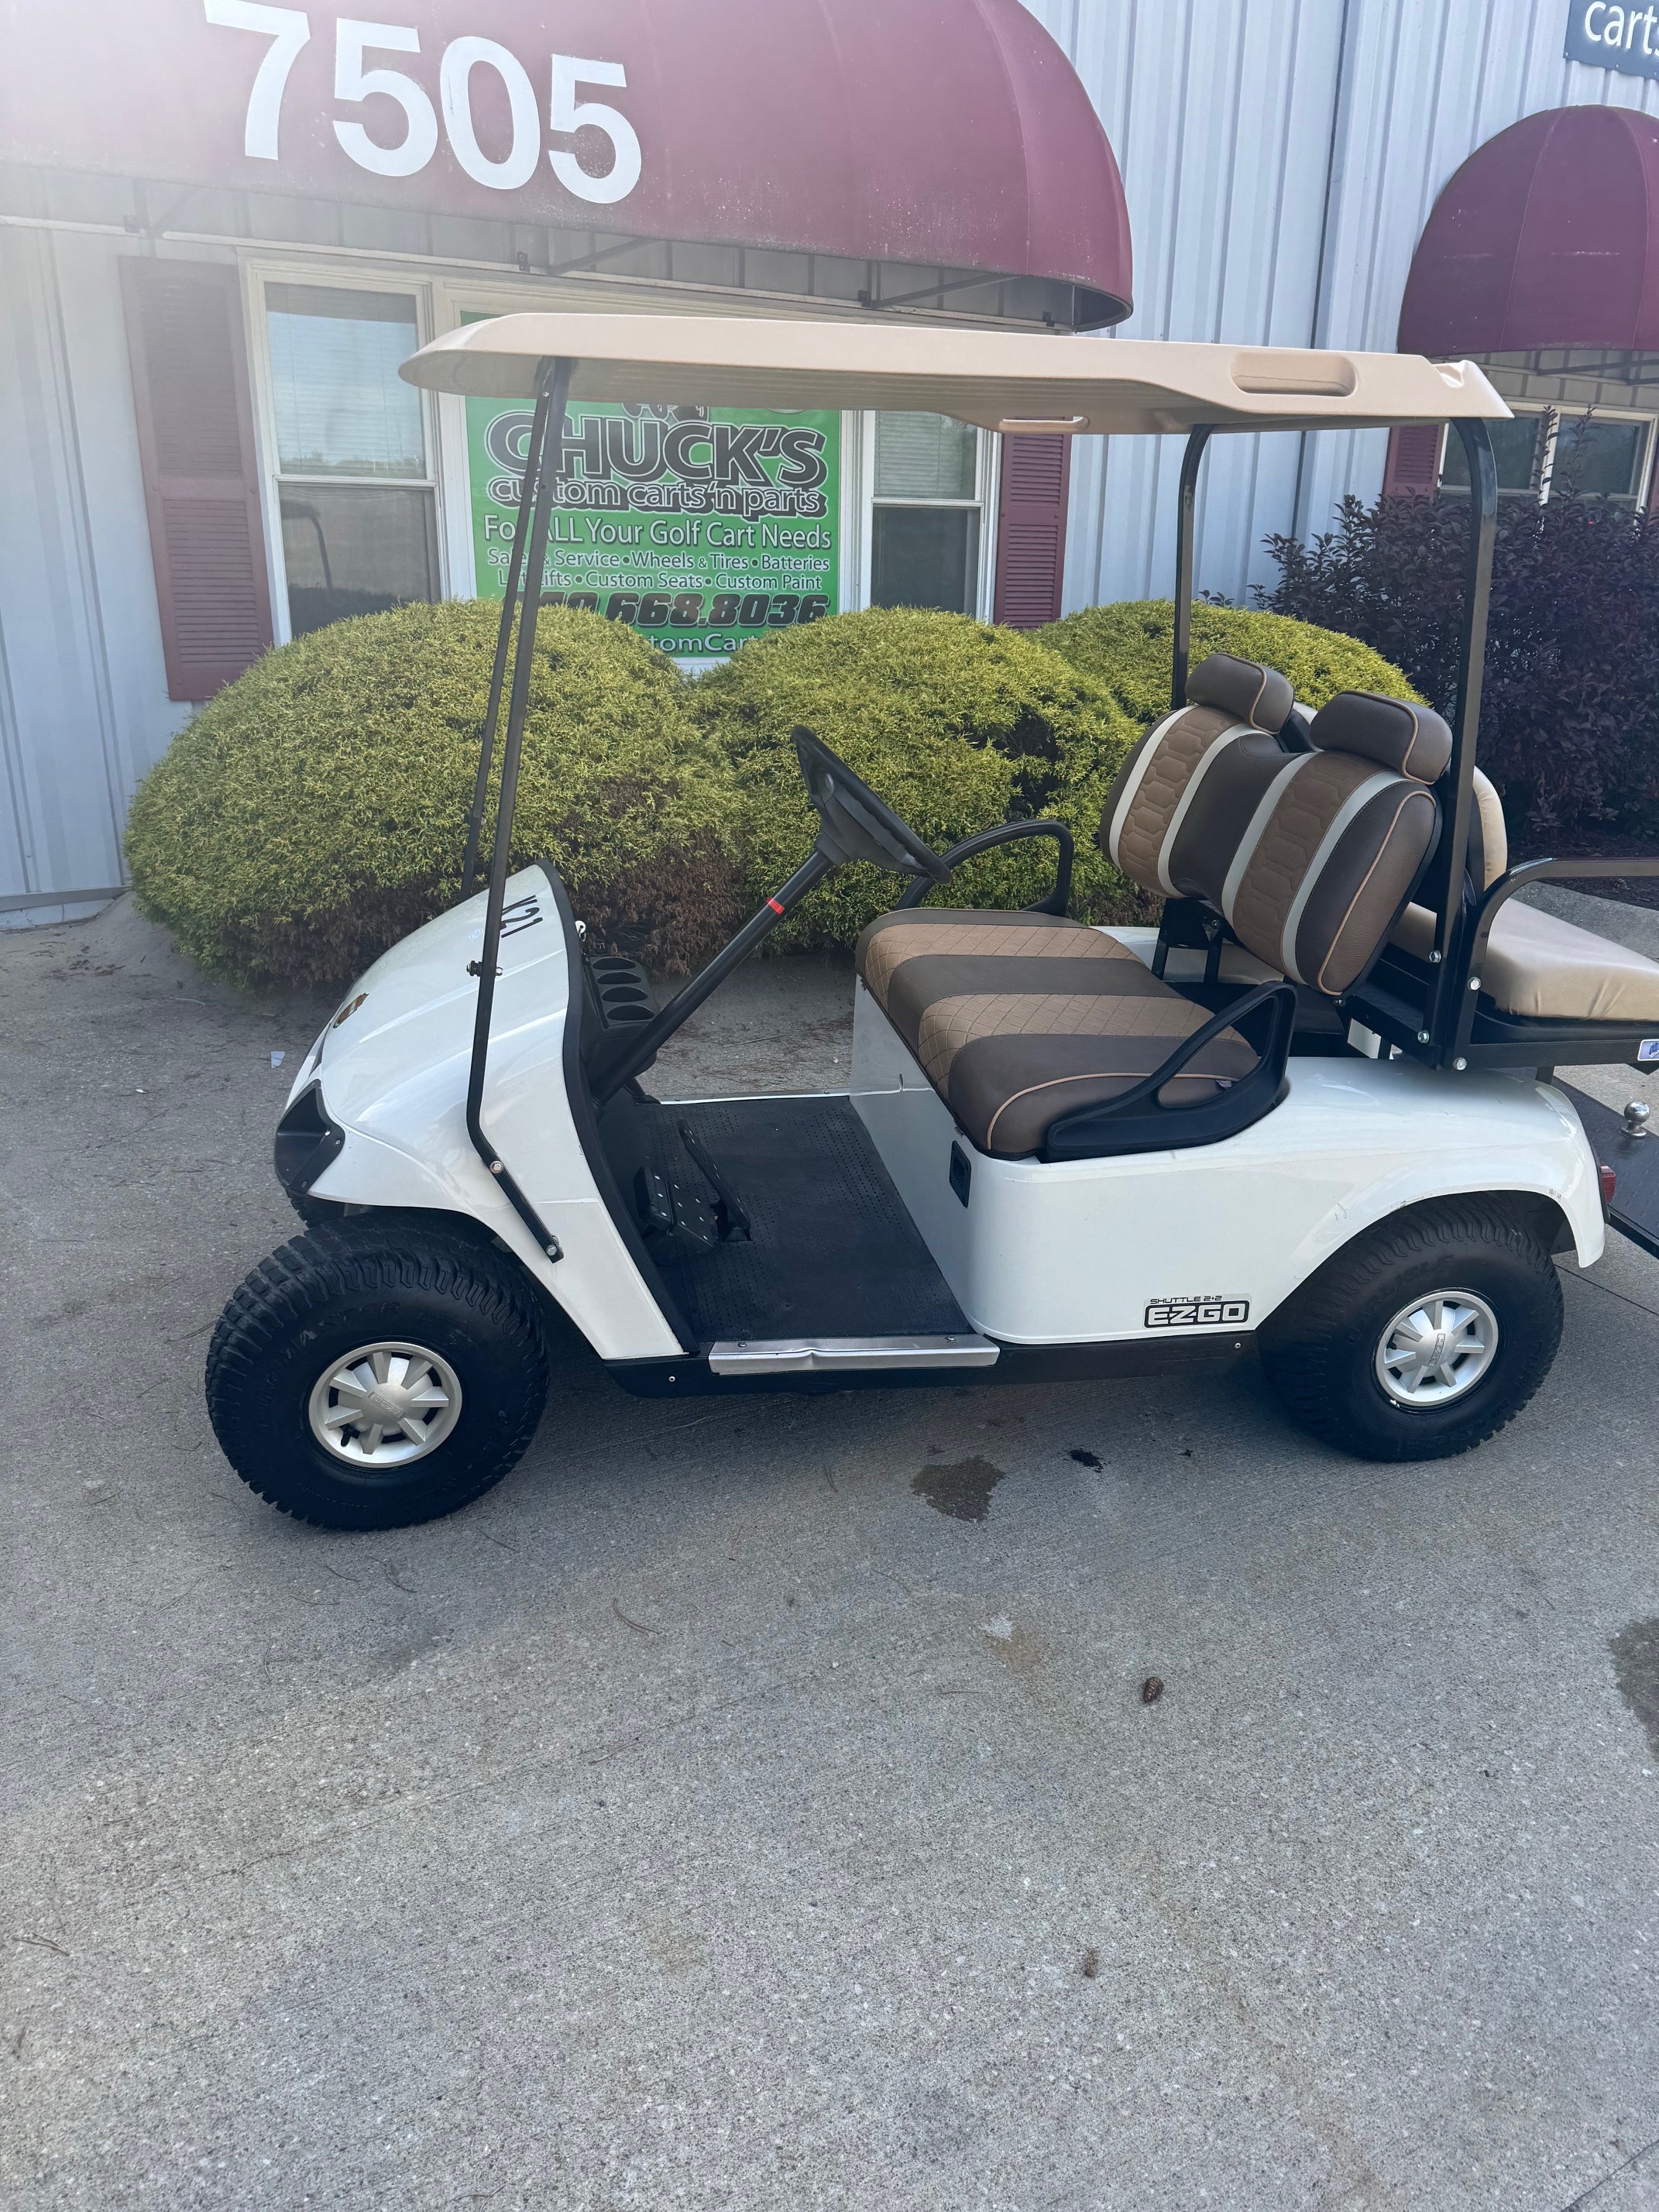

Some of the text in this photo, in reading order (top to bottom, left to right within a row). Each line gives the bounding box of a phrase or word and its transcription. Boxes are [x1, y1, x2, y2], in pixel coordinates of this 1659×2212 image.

[1585, 1, 1659, 57] cart
[203, 0, 642, 204] 7505
[485, 410, 827, 488] CHUCK'S
[742, 487, 821, 517] parts
[484, 514, 831, 548] Fo LL Your Golf Cart Needs
[555, 549, 620, 567] Service
[631, 551, 694, 568] Wheels
[699, 558, 707, 568] &
[709, 553, 748, 569] Tires
[761, 555, 830, 571] Batteries
[586, 571, 653, 588] Custom
[658, 572, 703, 589] Seats
[715, 574, 778, 589] Custom
[782, 575, 822, 590] Paint
[1149, 1296, 1201, 1304] SHUTTLE
